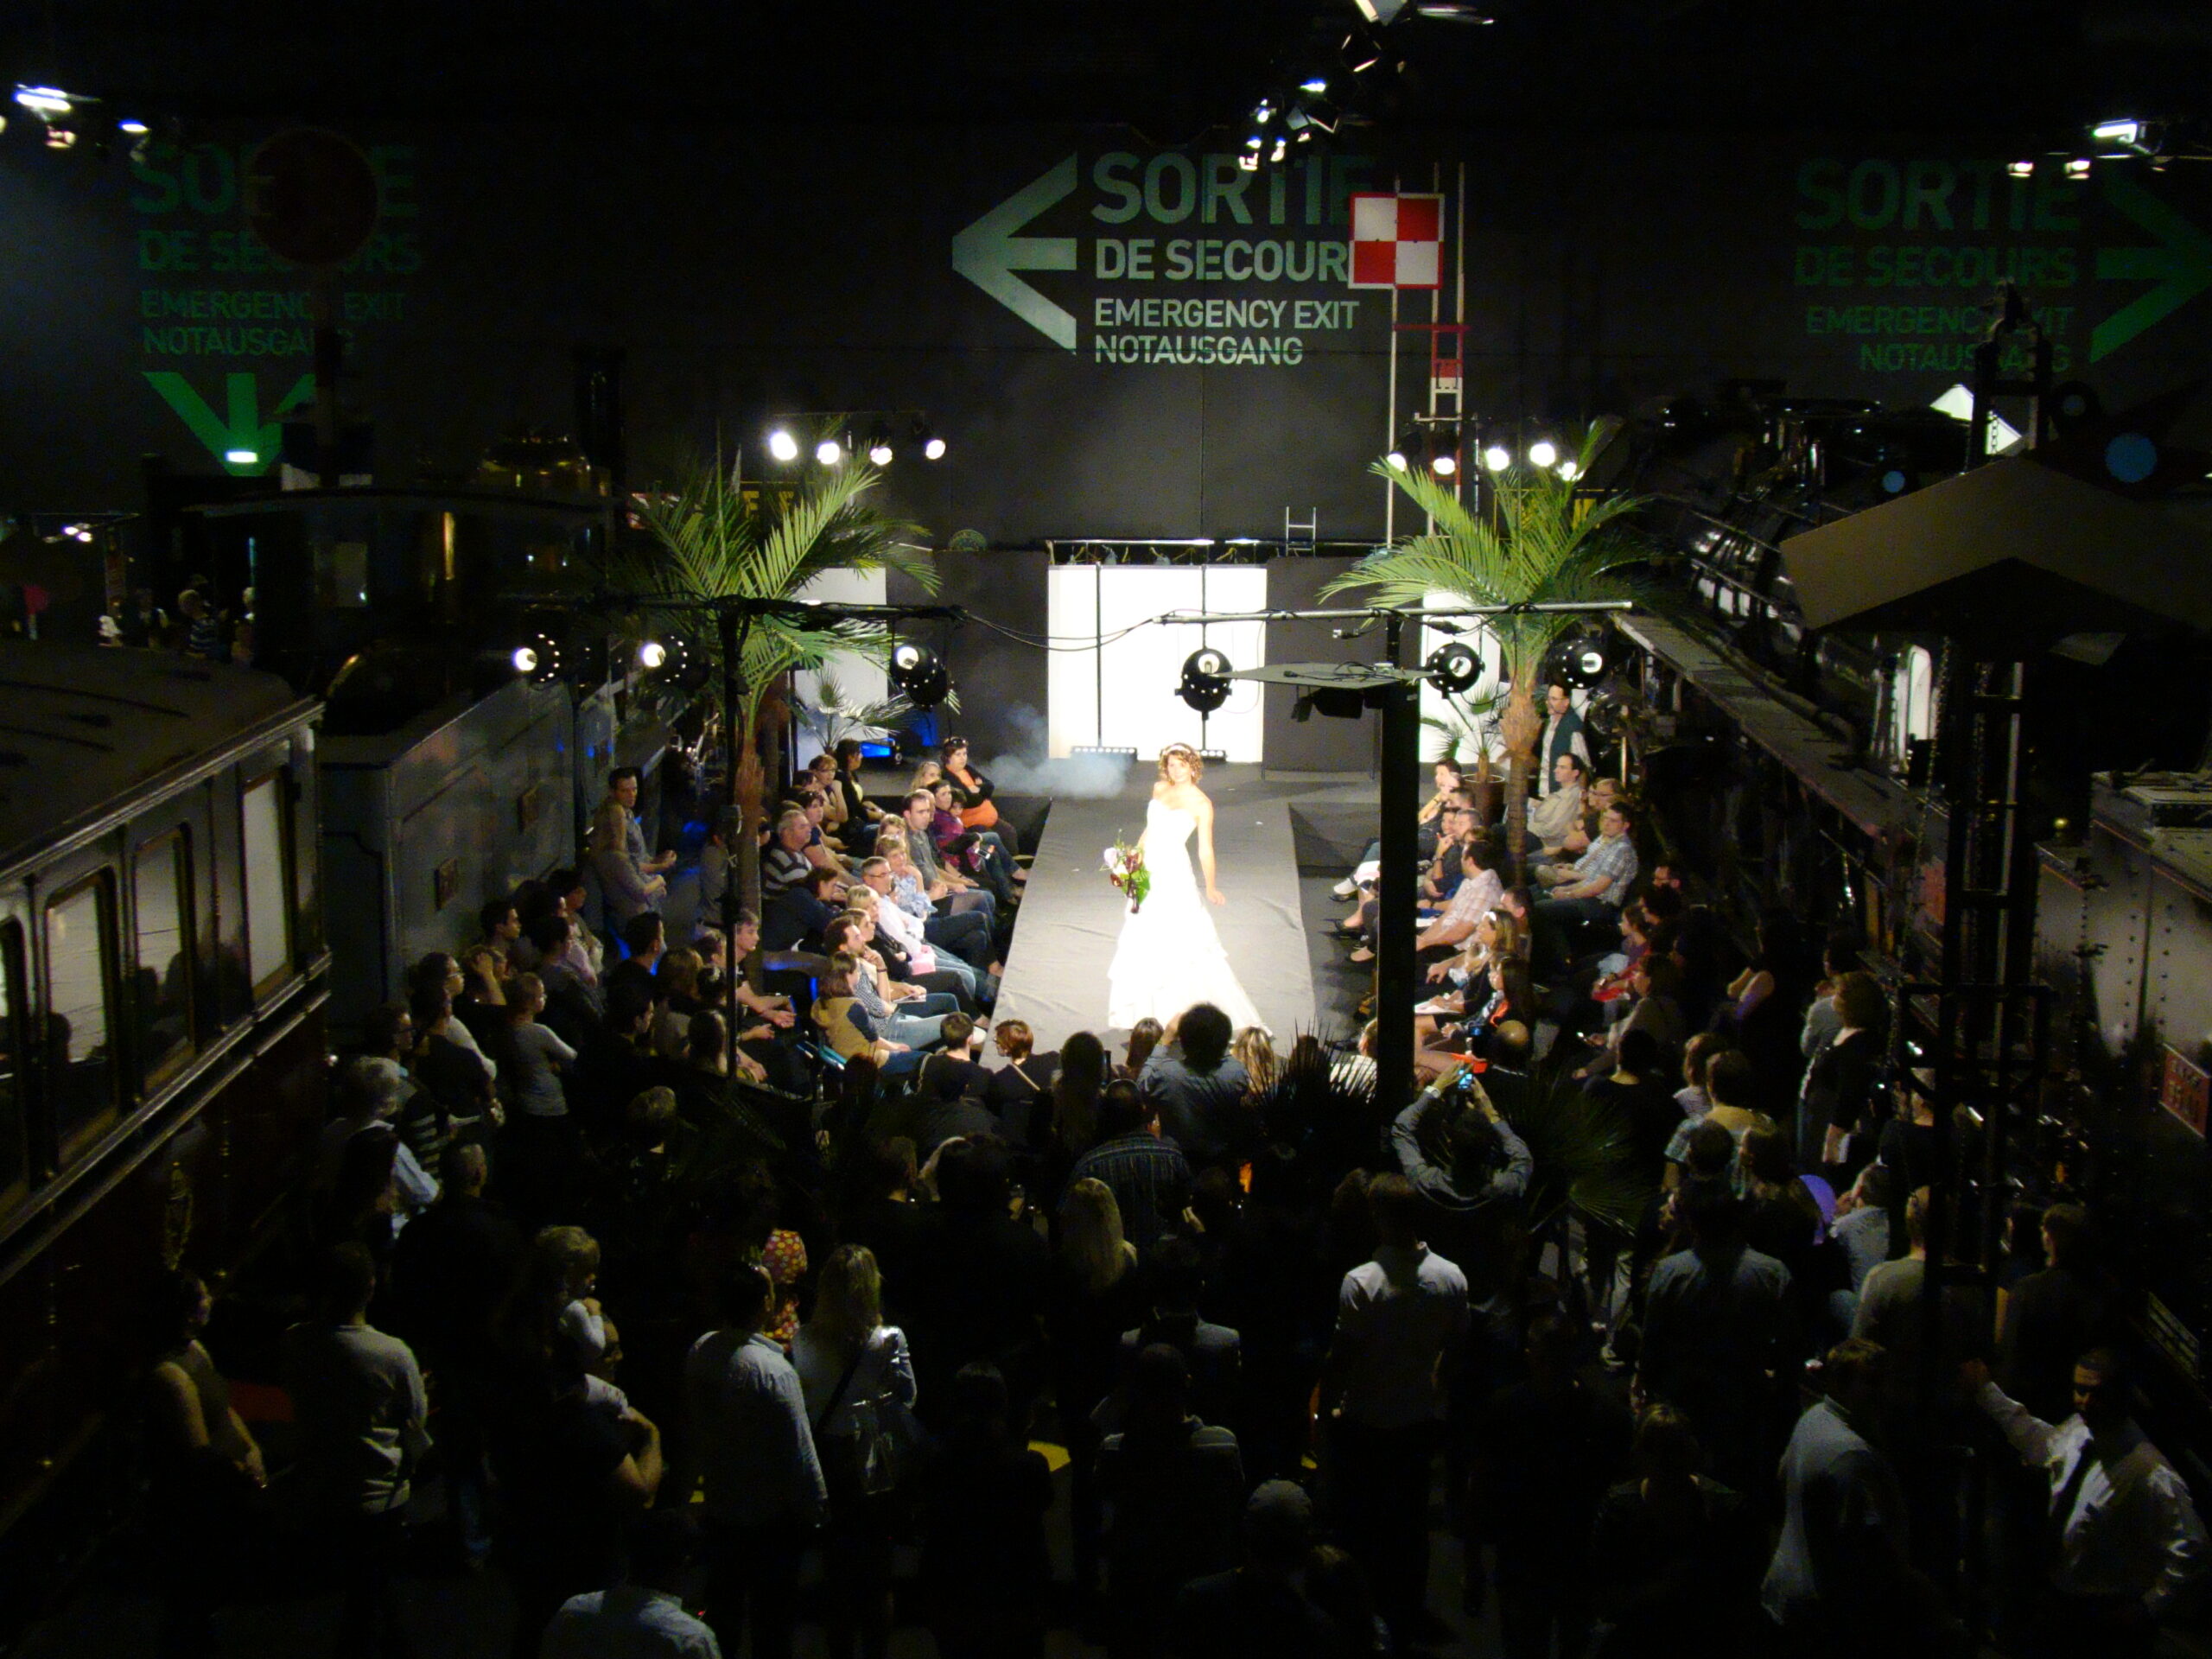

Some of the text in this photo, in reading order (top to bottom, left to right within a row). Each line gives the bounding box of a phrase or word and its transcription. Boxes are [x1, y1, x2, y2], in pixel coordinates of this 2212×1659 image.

[1795, 158, 2080, 231] SORTIE
[137, 229, 200, 271] DE
[1096, 238, 1349, 281] DE SECOUR
[1795, 245, 2079, 287] DE SECOURS
[140, 289, 407, 321] EMERGENC EXIT
[1095, 298, 1359, 329] EMERGENCY EXIT
[1806, 306, 1990, 335] EMERGENC
[1096, 334, 1303, 365] NOTAUSGANG
